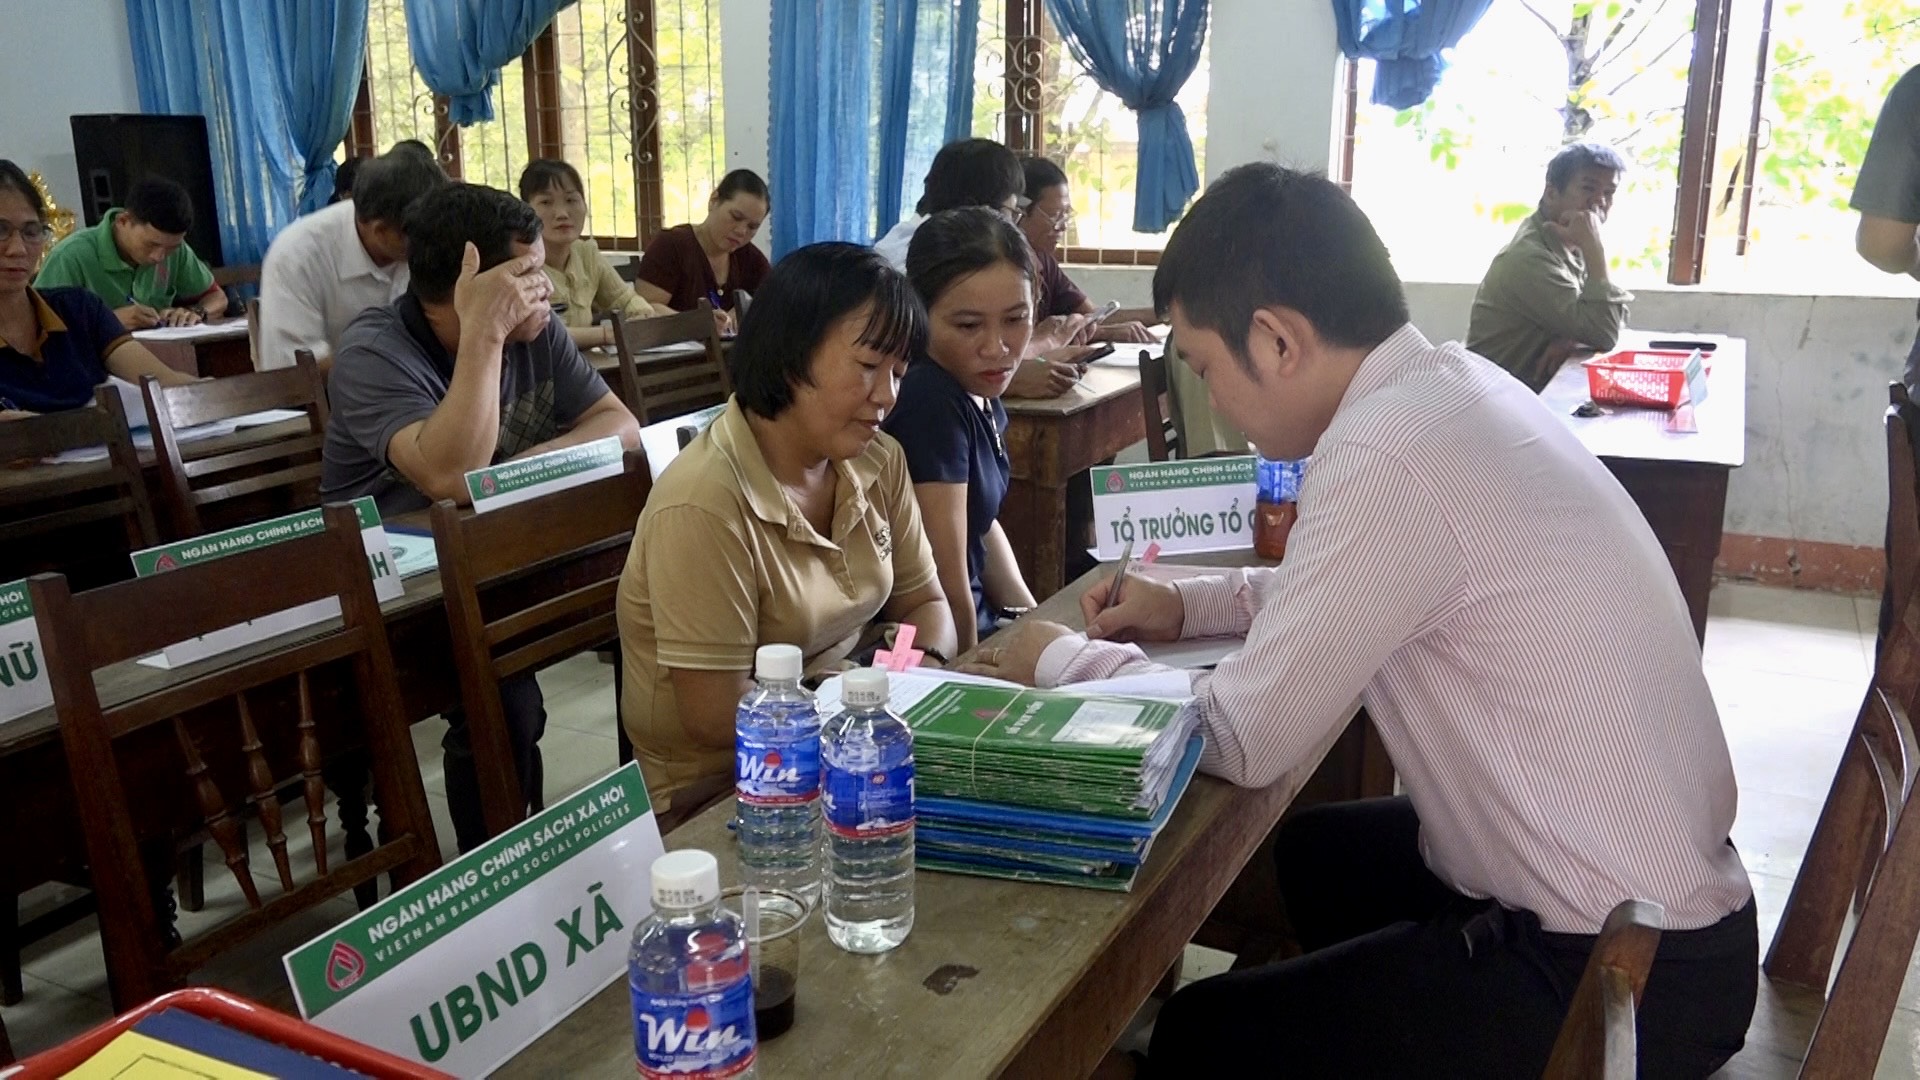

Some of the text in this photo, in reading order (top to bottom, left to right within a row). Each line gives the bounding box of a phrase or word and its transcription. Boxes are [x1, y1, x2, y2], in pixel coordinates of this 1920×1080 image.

[1129, 469, 1159, 480] NGÂN
[1139, 506, 1214, 540] TRƯỞNG
[1218, 497, 1242, 534] TỔ
[181, 541, 219, 560] NGÂN
[737, 751, 802, 782] Win
[368, 899, 425, 944] NGÂN
[426, 869, 478, 910] HÀNG
[480, 838, 532, 877] CHÍNH
[533, 812, 576, 848] SÁCH
[375, 803, 630, 962] VIETNAM BANK FOR SOCIAL POLICIES
[409, 881, 624, 1063] UBND XÃ
[640, 1013, 742, 1054] Win
